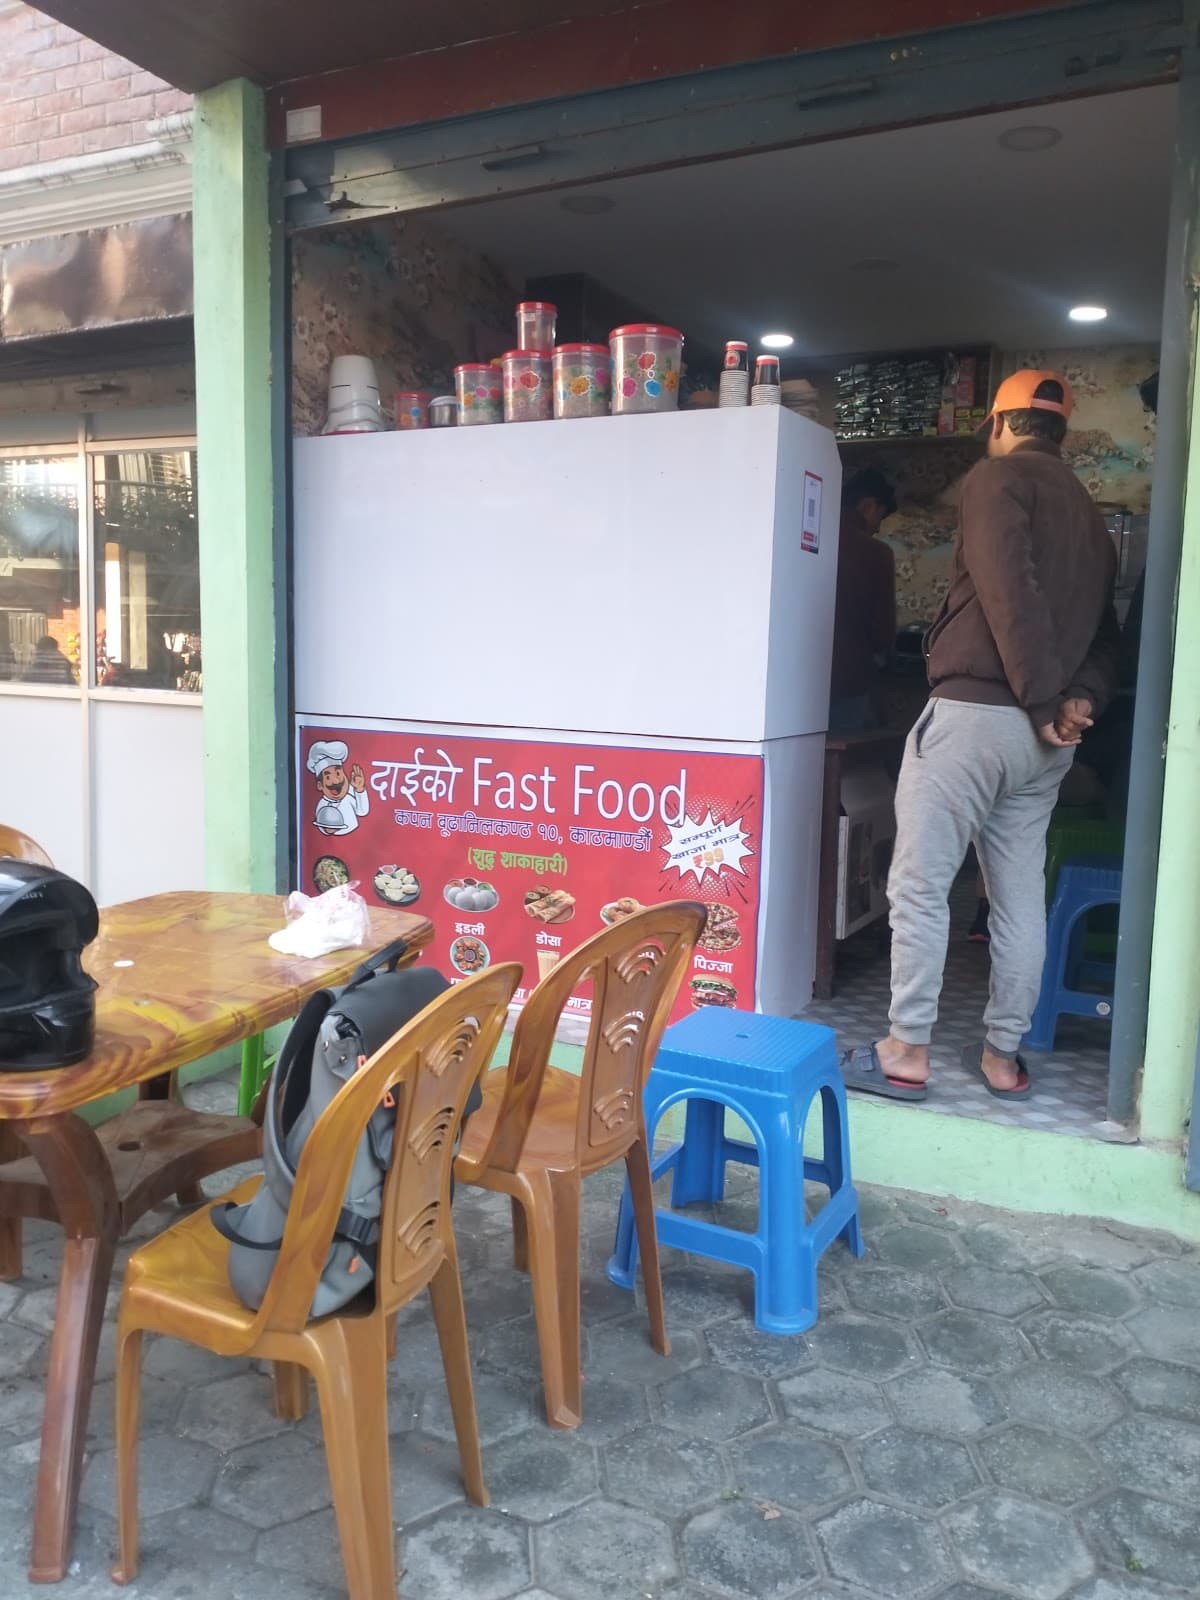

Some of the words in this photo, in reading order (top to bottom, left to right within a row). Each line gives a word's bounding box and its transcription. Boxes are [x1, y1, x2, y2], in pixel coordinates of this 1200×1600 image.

[371, 747, 464, 807] दाईको
[473, 757, 557, 814] Fast
[573, 764, 687, 826] Food
[394, 809, 434, 829] कपन
